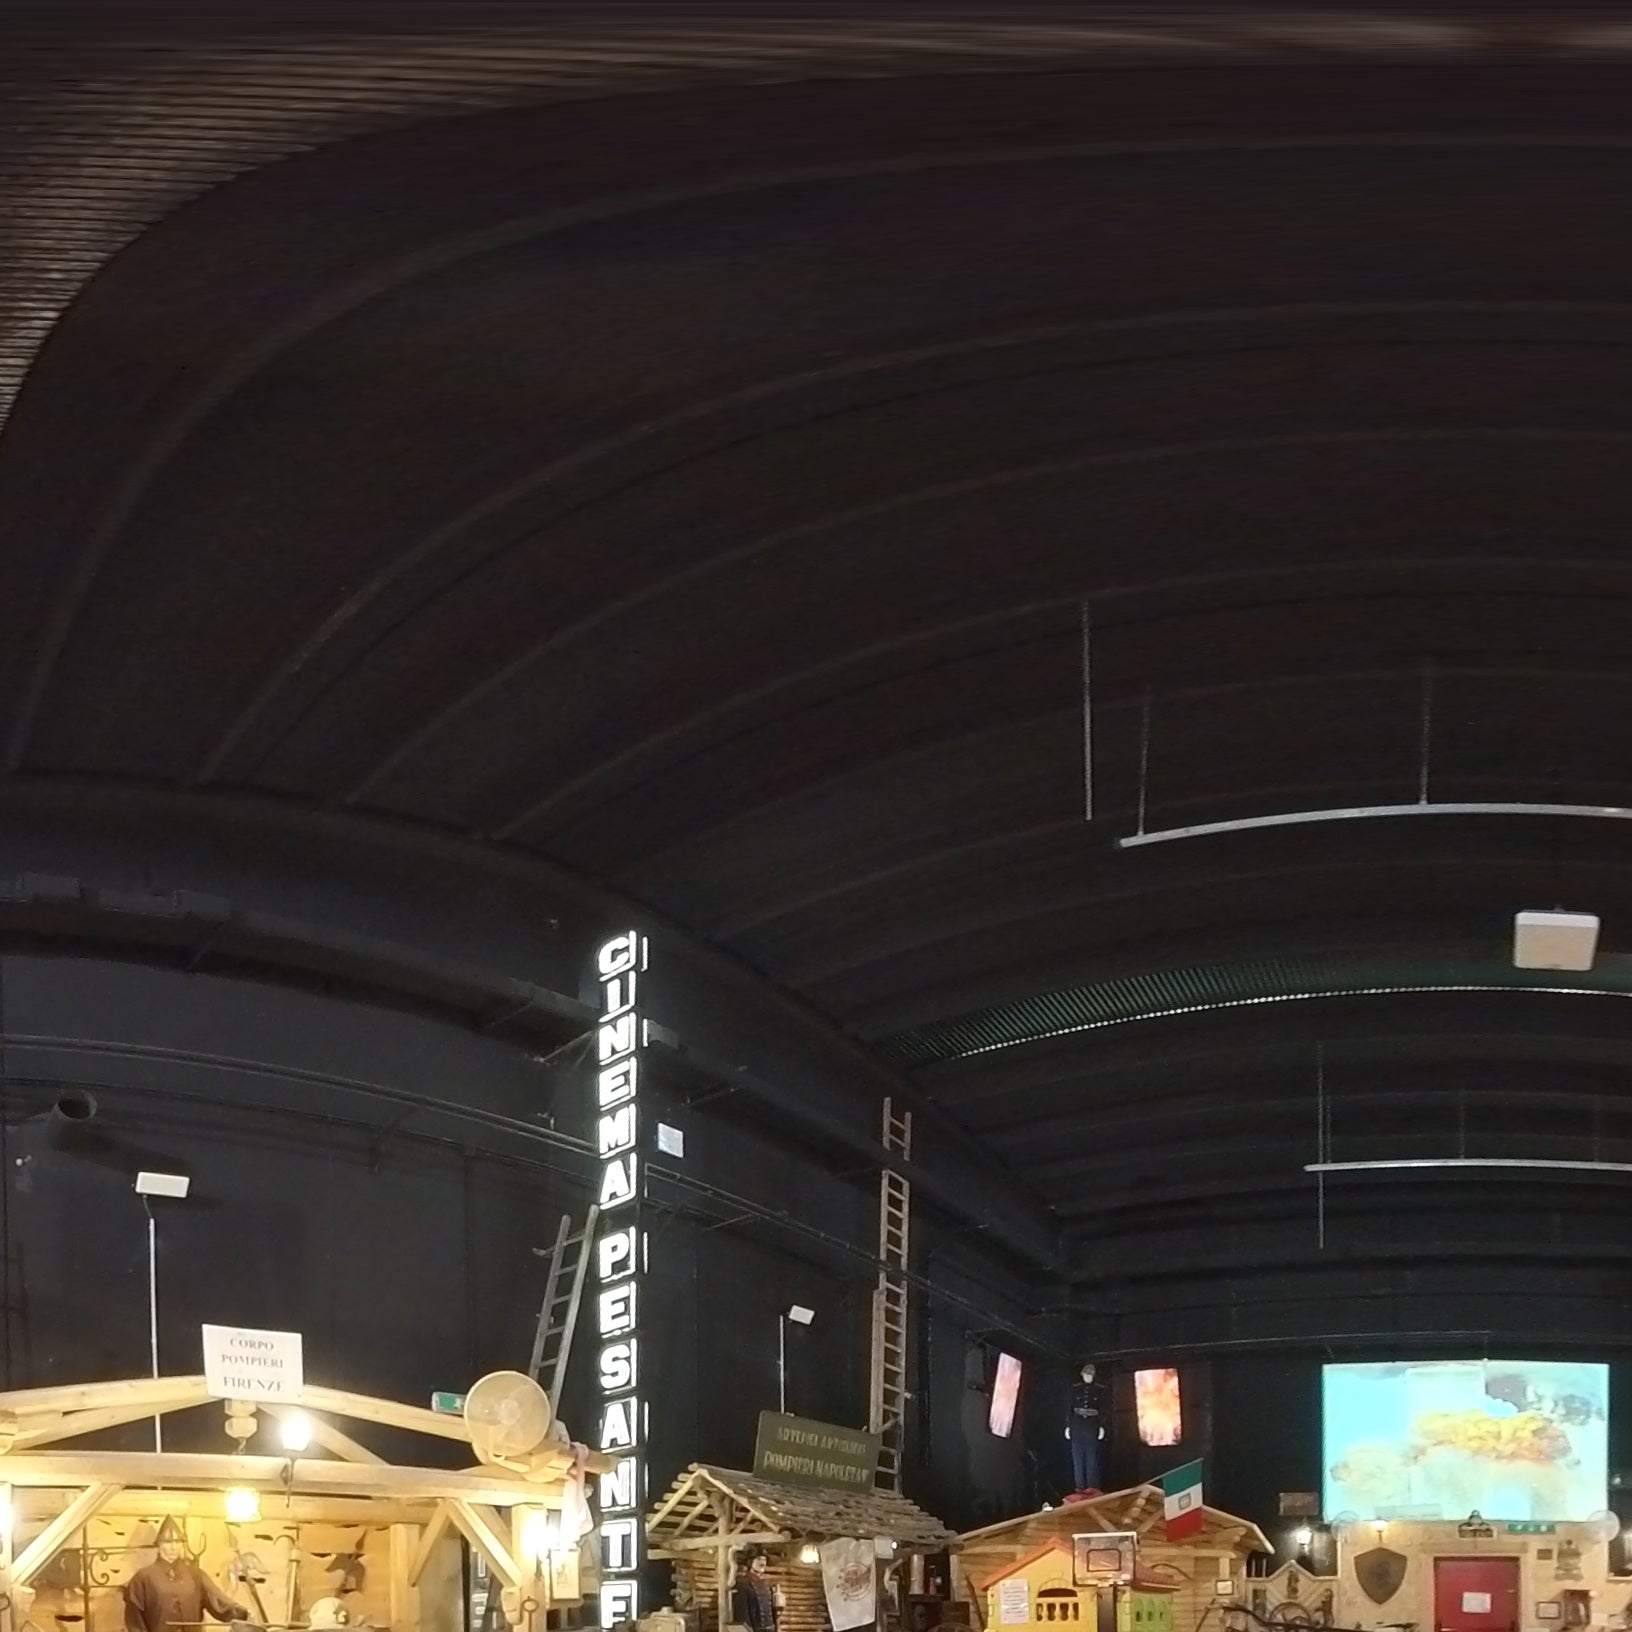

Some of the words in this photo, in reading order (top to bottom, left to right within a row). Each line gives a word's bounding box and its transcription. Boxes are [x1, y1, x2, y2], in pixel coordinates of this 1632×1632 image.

[598, 935, 630, 1203] CINEMA
[230, 1338, 274, 1350] CORPO
[221, 1353, 283, 1368] POMPIERI
[223, 1375, 281, 1392] FIRENZE
[598, 1232, 631, 1632] PESANTE
[763, 1450, 815, 1475] POMPIERI
